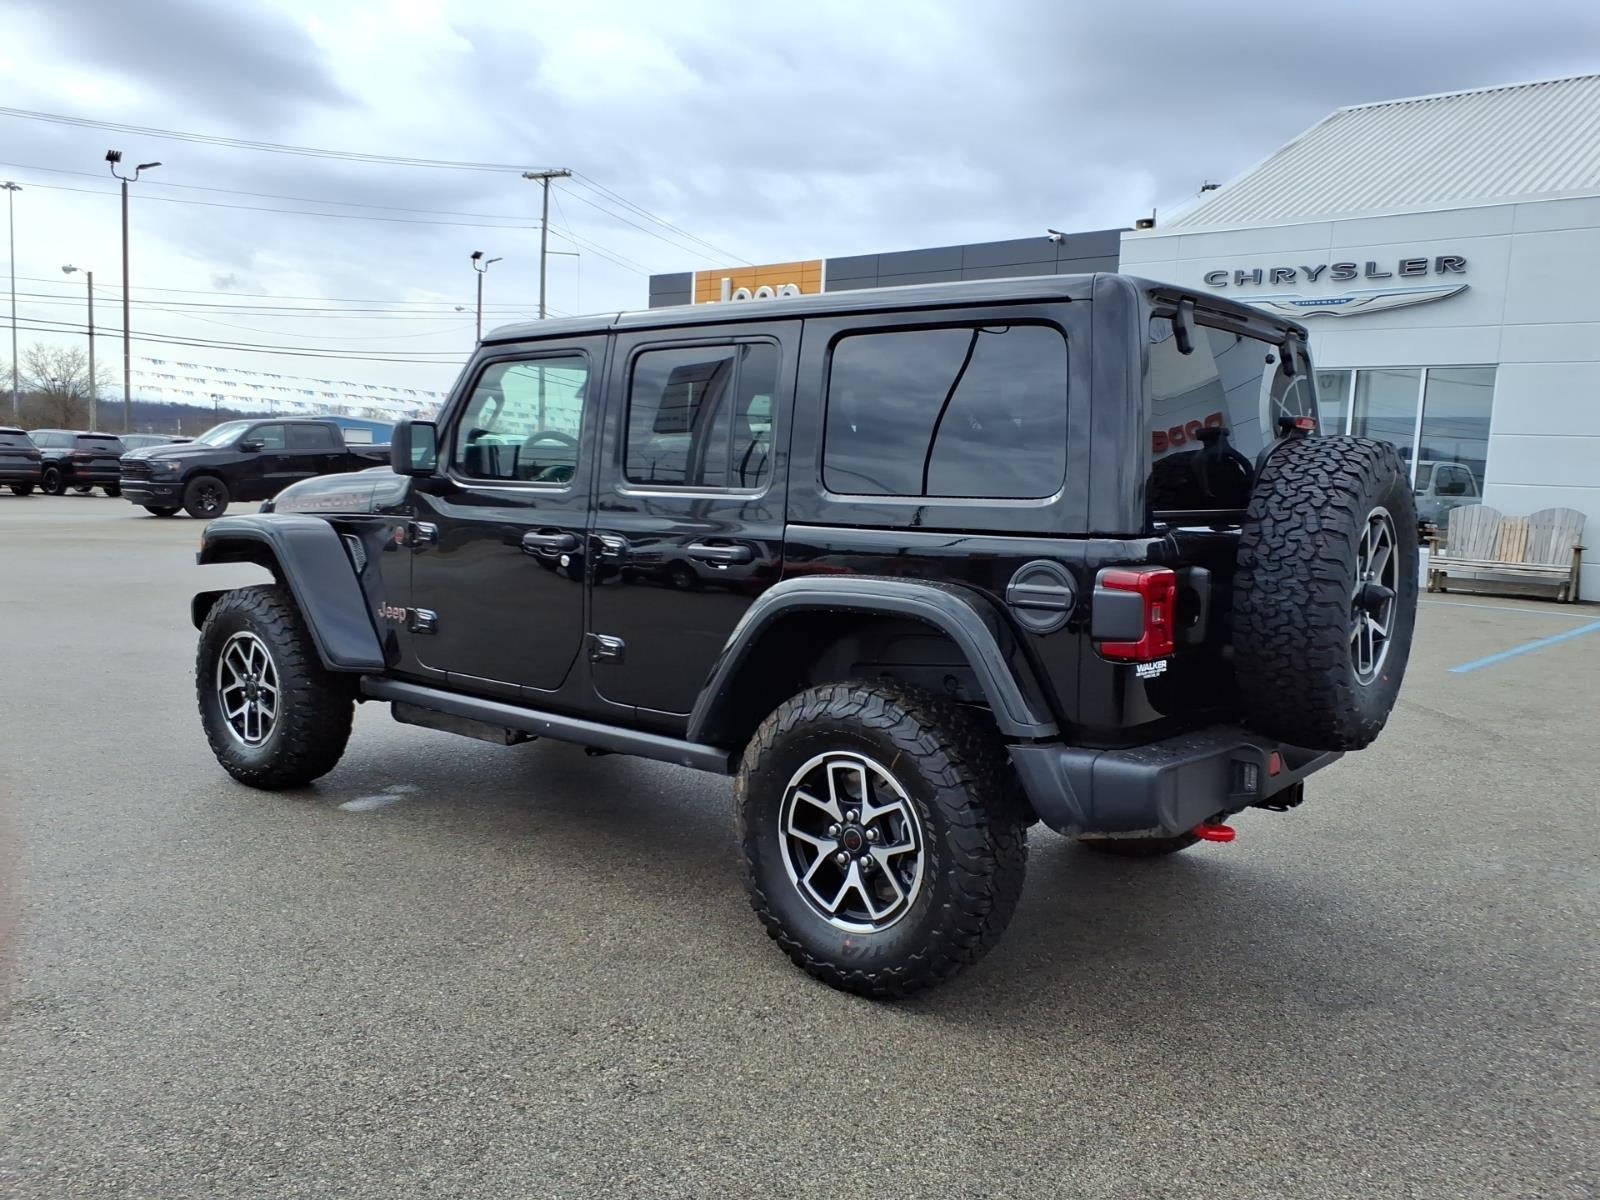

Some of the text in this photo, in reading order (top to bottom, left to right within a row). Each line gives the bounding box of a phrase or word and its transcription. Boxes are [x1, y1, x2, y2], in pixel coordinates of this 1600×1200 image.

[1203, 255, 1468, 287] CHRYSLER
[378, 601, 407, 624] Jeep
[1136, 660, 1167, 673] WALKER
